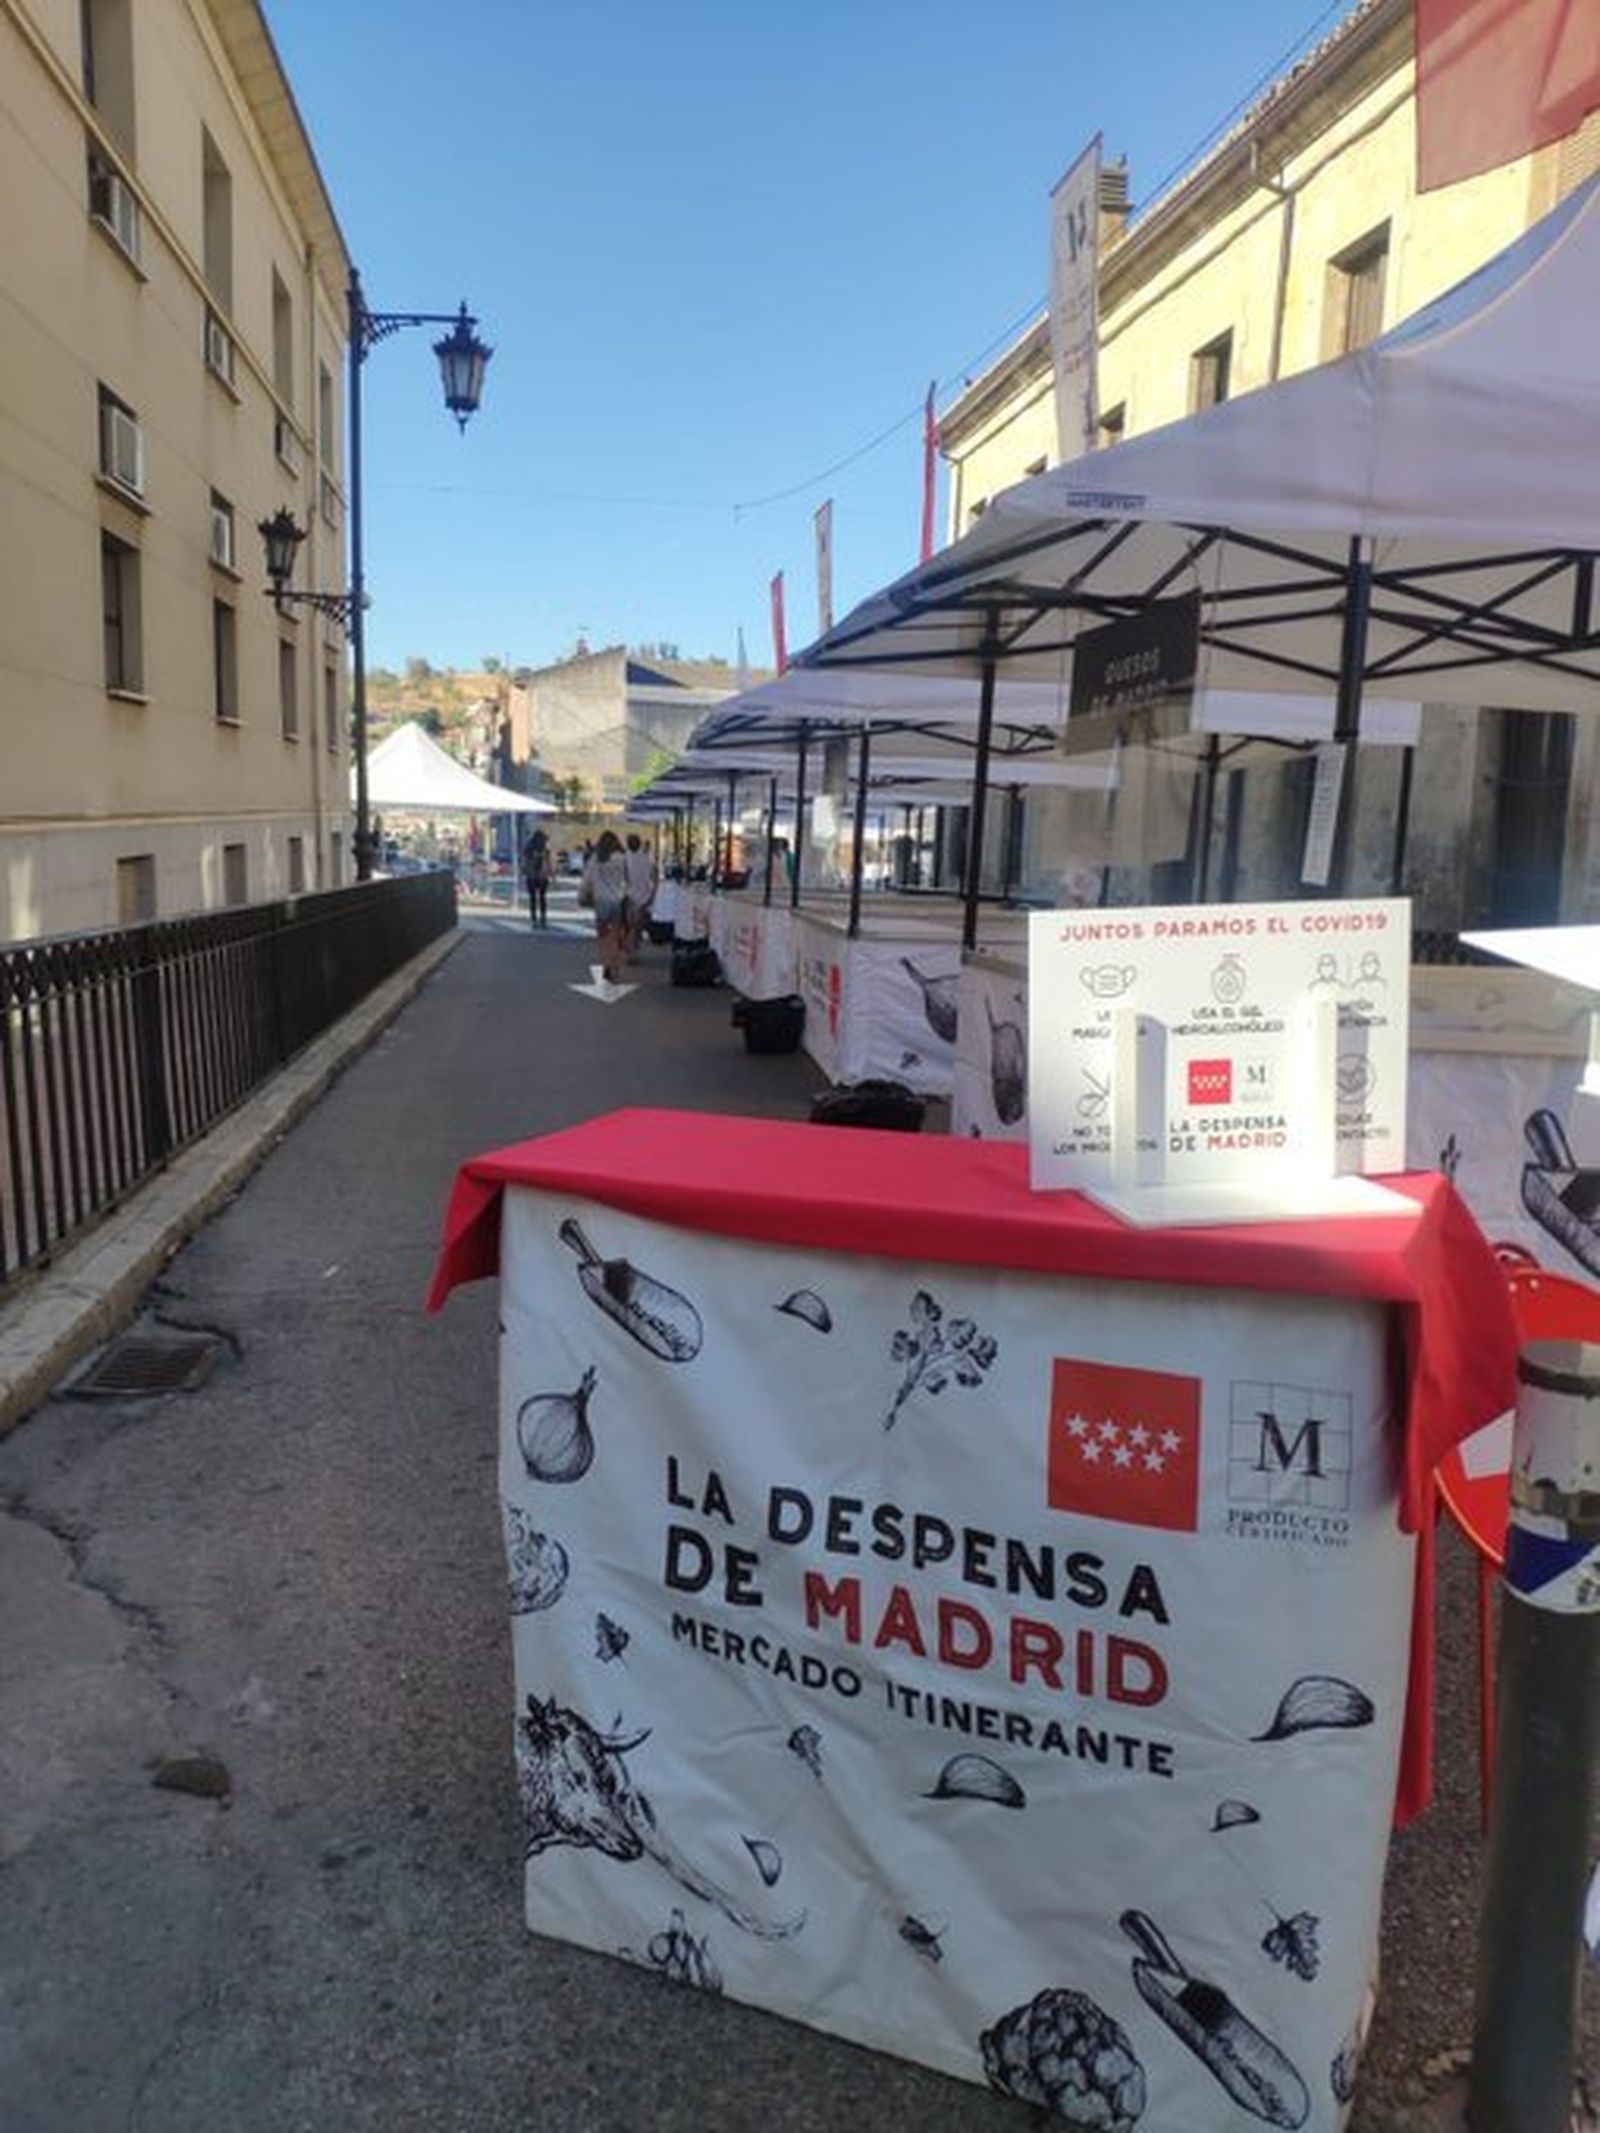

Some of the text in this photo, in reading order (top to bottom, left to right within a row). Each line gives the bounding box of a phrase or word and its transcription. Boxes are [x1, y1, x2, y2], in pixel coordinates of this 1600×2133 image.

[1060, 914, 1388, 942] JUNTOS PARAMOS EL COVID19
[1170, 1113, 1287, 1134] LA DESPENSA
[1170, 1132, 1288, 1153] DE MADRID
[1255, 1411, 1327, 1479] M
[667, 1454, 1171, 1626] LA DESPENSA
[1227, 1507, 1350, 1534] PRODUCTO
[664, 1524, 1170, 1708] DE MADRID
[671, 1611, 1175, 1778] MERCADO ITINERANTE
